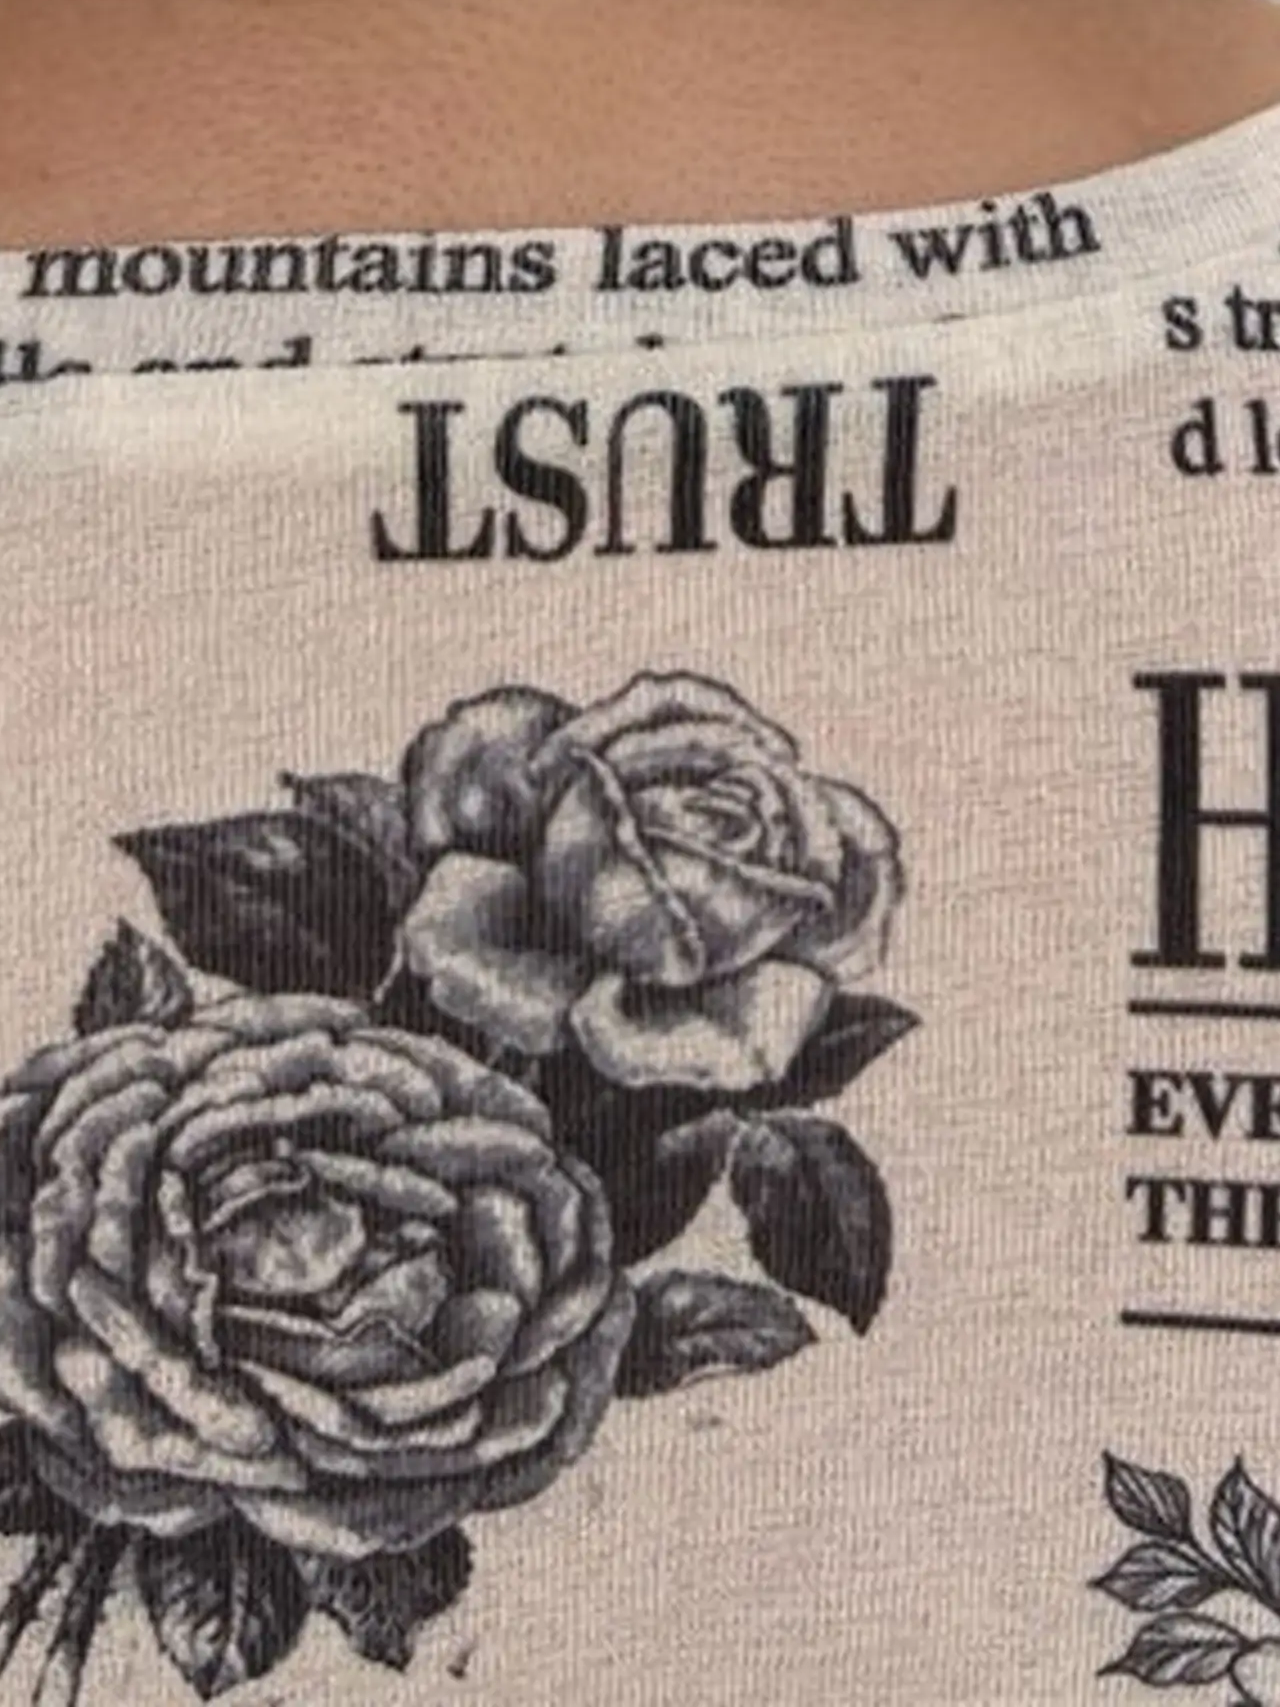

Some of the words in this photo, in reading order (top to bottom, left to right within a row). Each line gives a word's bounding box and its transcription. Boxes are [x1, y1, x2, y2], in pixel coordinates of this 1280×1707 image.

[20, 232, 556, 298] mountains
[595, 216, 861, 293] laced
[887, 191, 1102, 282] with
[1162, 295, 1204, 352] s
[372, 375, 959, 563] TRUST
[1170, 396, 1225, 477] d
